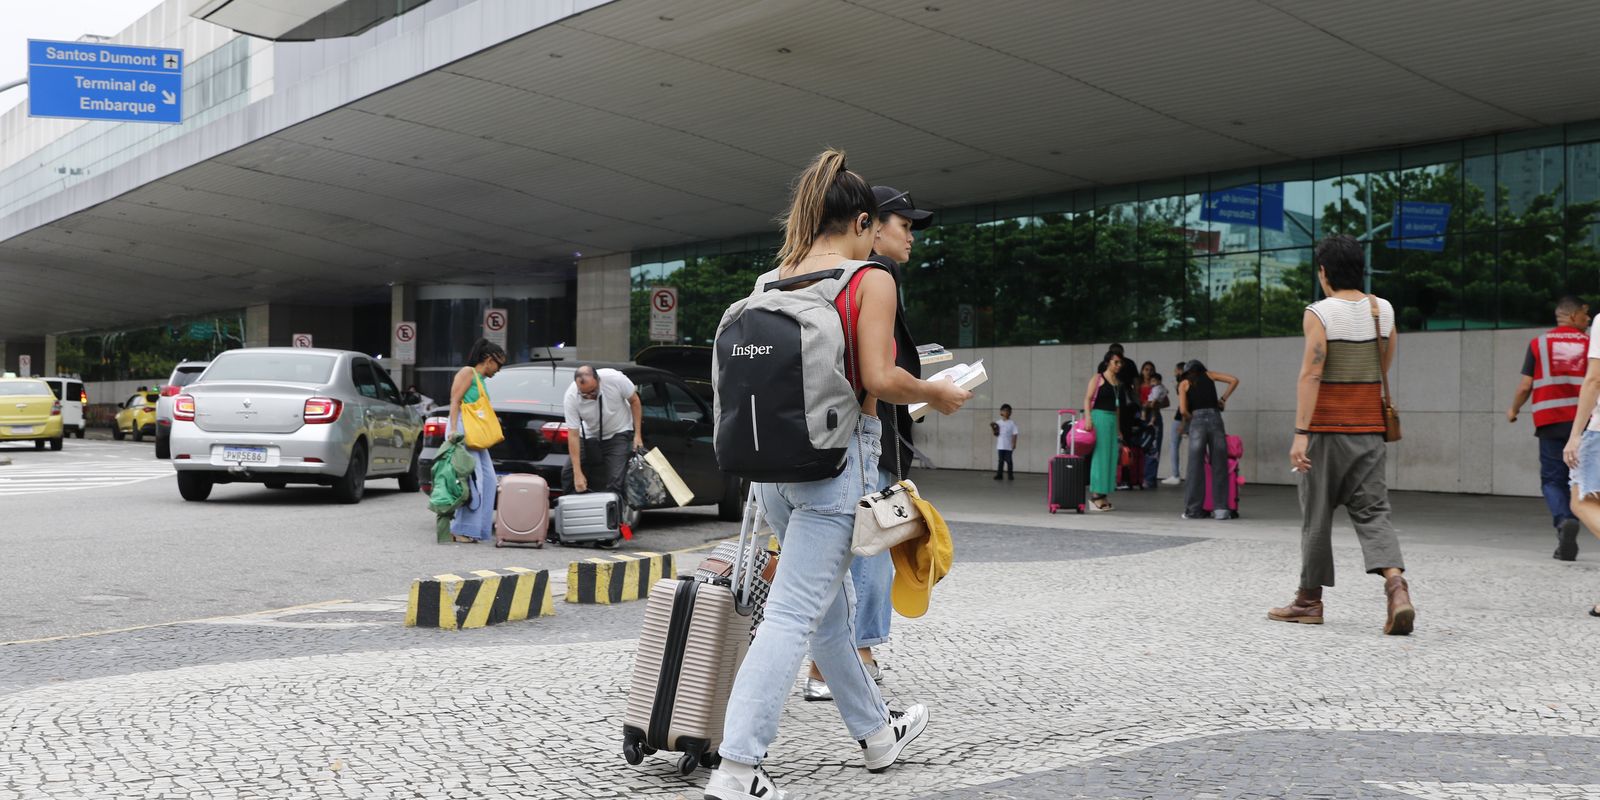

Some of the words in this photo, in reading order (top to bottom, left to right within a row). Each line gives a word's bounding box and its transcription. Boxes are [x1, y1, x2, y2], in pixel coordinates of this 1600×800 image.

[46, 47, 97, 62] Santos
[100, 50, 157, 66] Dumont
[74, 76, 136, 92] Terminal
[139, 81, 156, 92] de
[80, 97, 156, 115] Embarque
[731, 344, 773, 359] Insper
